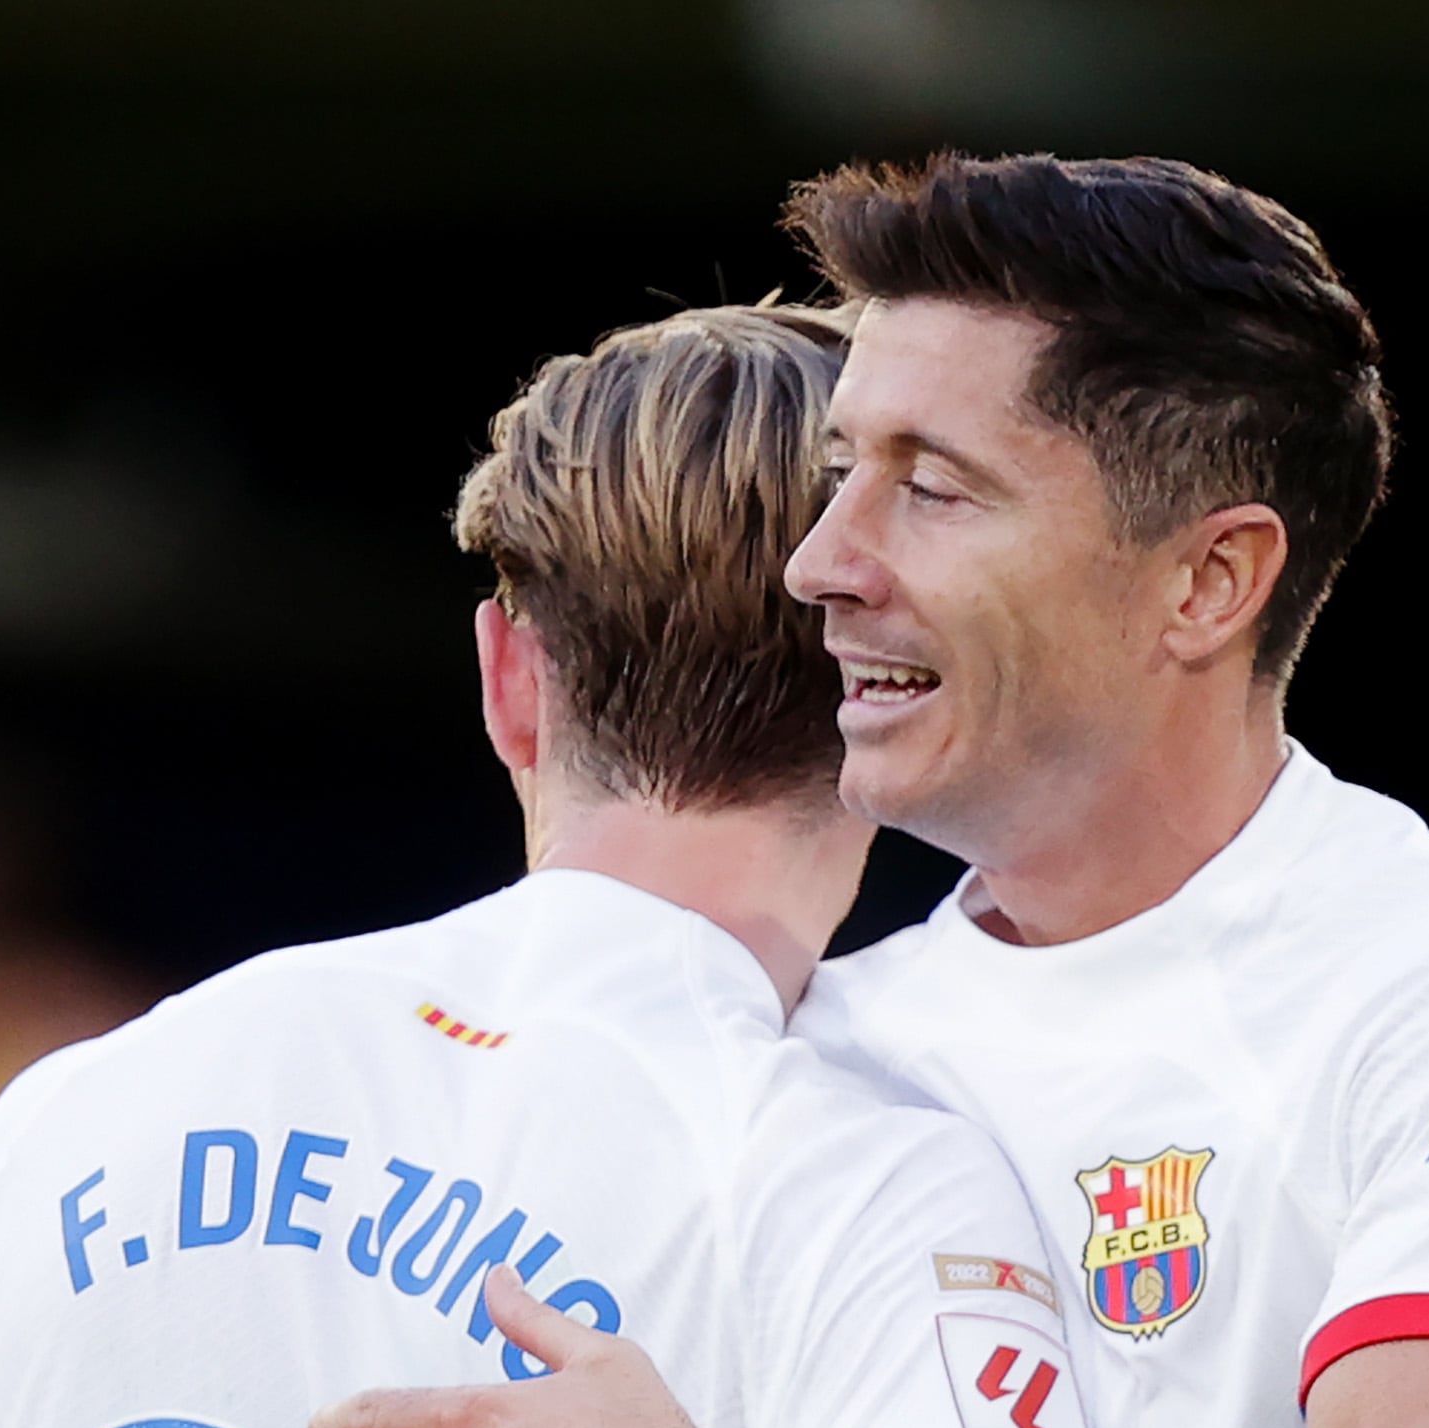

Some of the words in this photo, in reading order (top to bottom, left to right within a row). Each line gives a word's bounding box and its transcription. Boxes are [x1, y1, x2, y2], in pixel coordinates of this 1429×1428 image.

[60, 1167, 151, 1294] F.
[177, 1128, 350, 1252] DE
[1105, 1223, 1190, 1259] F.C.B.
